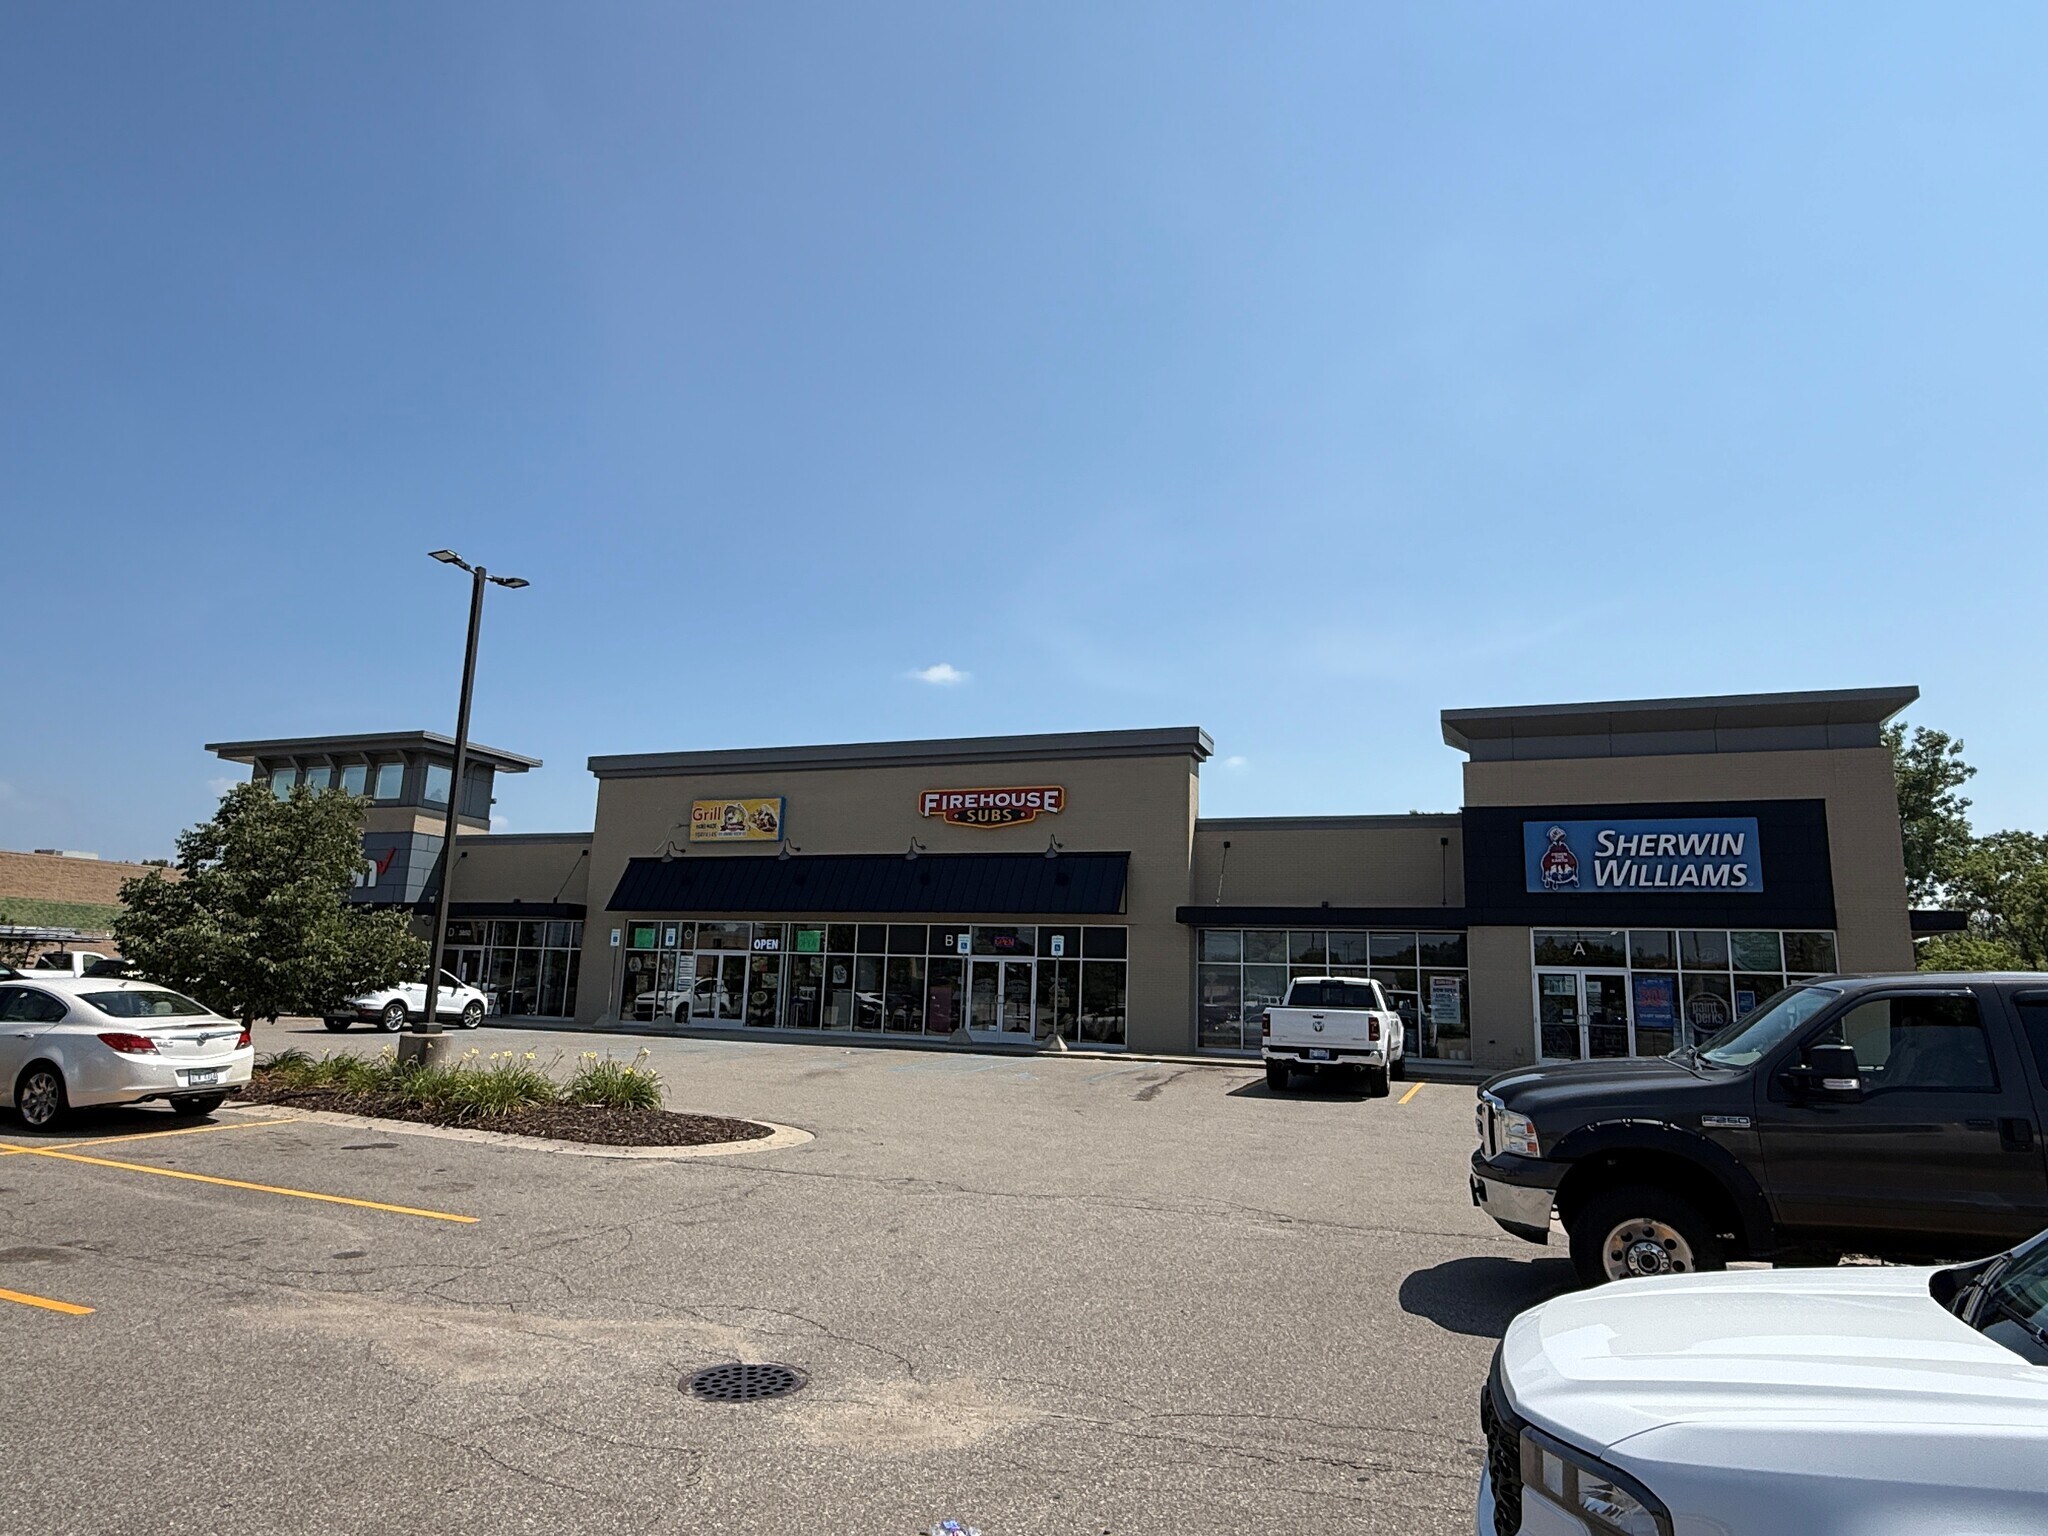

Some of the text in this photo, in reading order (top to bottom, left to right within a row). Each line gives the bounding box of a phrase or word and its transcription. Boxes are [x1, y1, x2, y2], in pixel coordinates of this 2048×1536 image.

[924, 790, 1059, 817] FIREHOUSE
[692, 806, 721, 821] Grill
[966, 808, 1012, 822] SUBS
[1595, 830, 1745, 857] SHERWIN
[1594, 859, 1748, 888] WILLIAMS
[448, 928, 455, 937] D
[754, 939, 779, 950] OPEN
[945, 934, 954, 947] B
[1573, 942, 1586, 956] A
[1692, 1000, 1718, 1016] paint
[1695, 1010, 1724, 1025] perks
